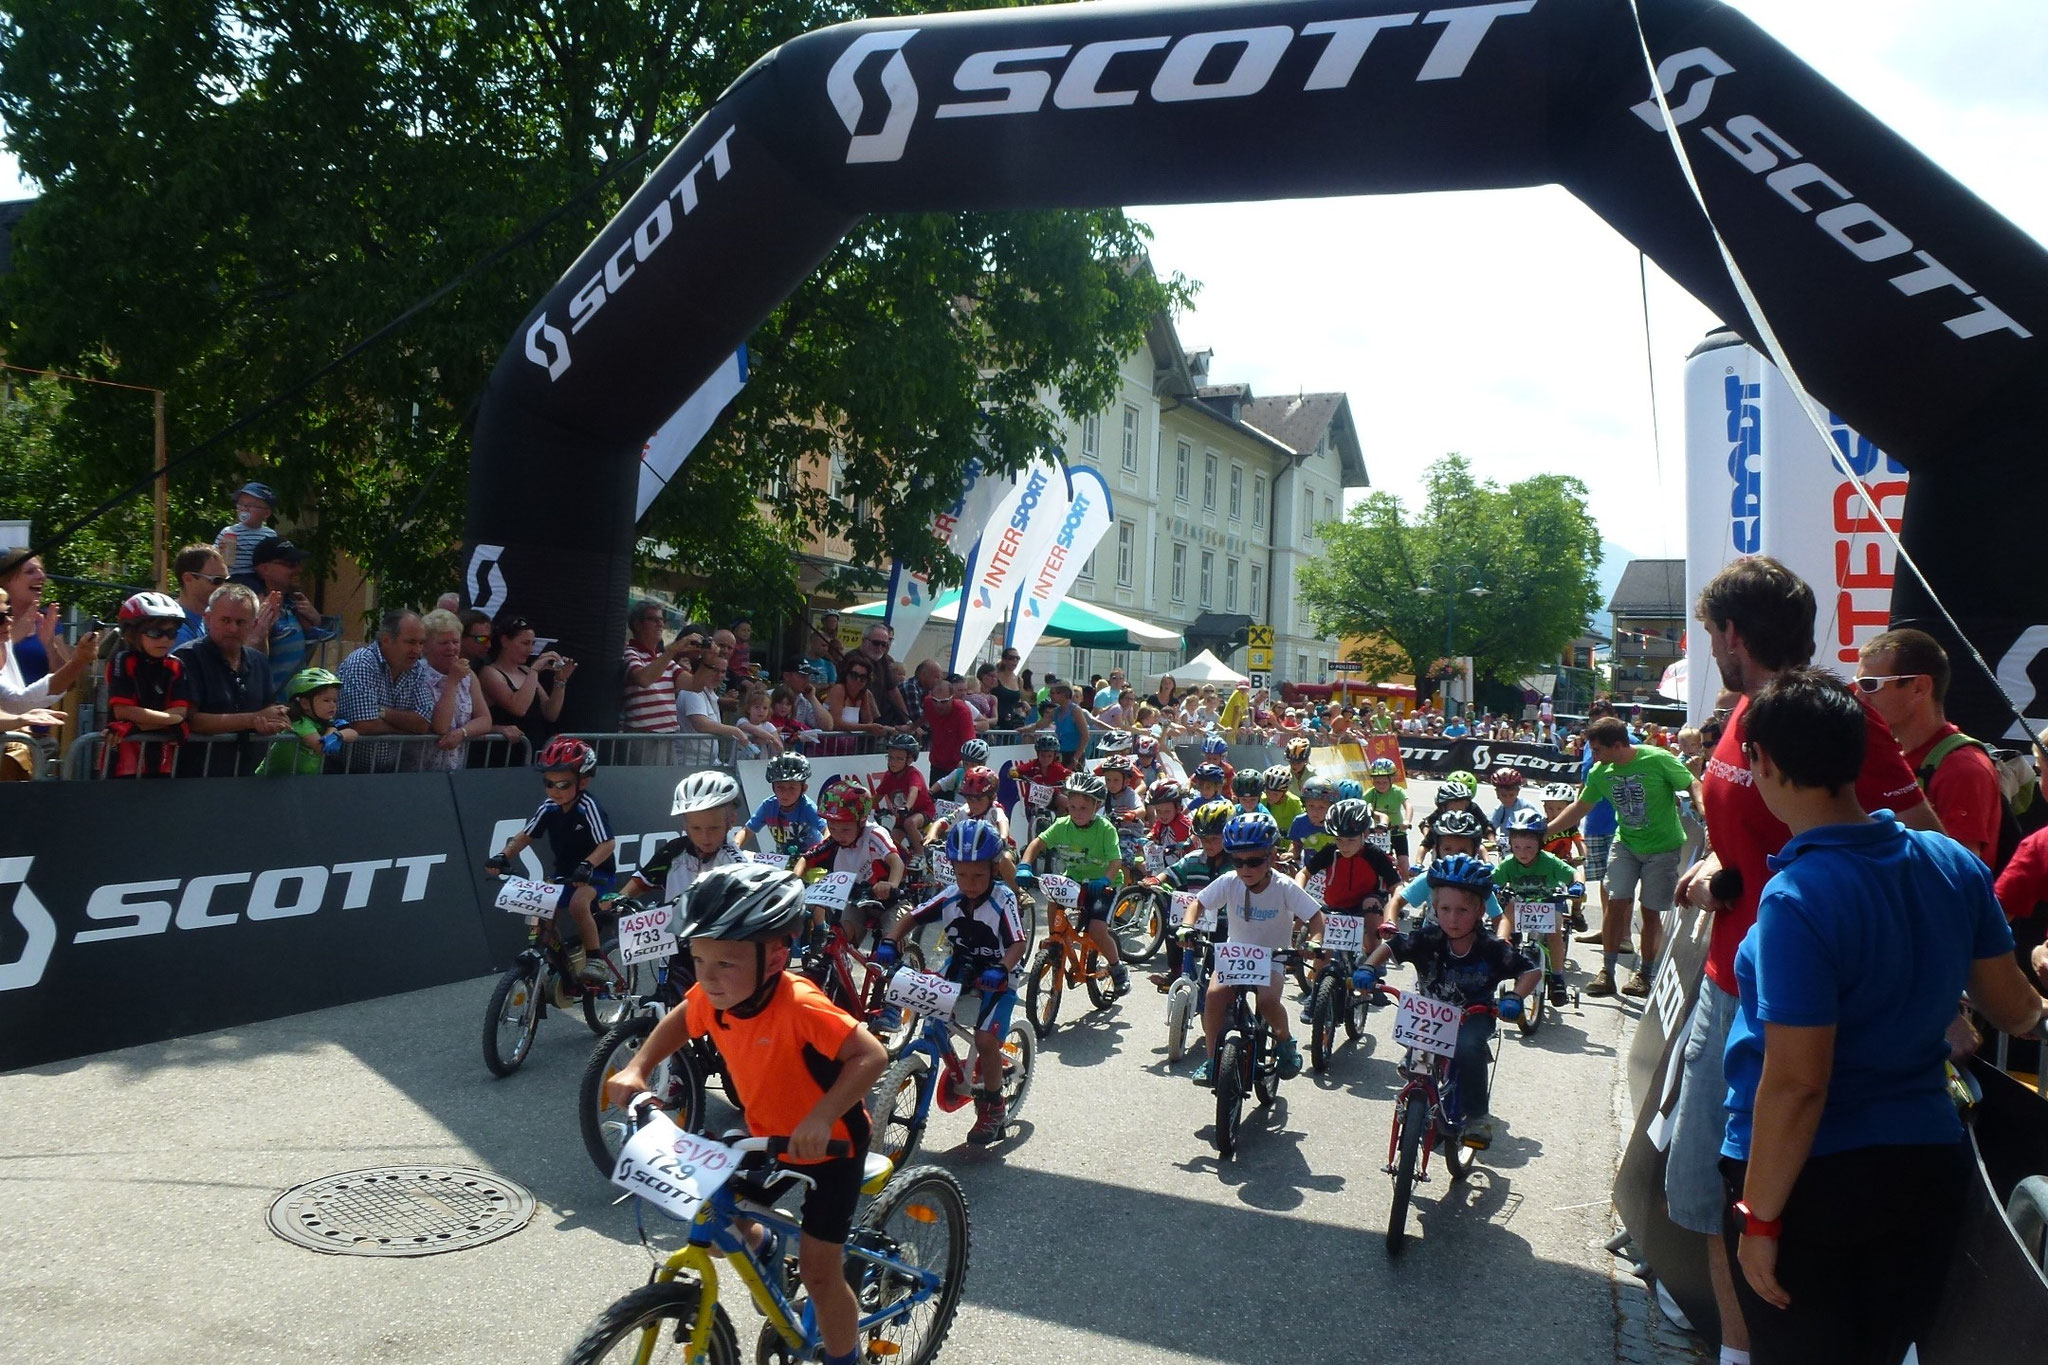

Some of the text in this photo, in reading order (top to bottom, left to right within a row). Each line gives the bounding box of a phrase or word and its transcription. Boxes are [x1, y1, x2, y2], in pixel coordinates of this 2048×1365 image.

[935, 1, 1537, 119] SCOTT
[571, 124, 736, 335] SCOTT
[1701, 114, 2034, 340] SCOTT
[983, 469, 1049, 589] INTERSPORT
[1032, 492, 1091, 600] INTERSPORT
[1401, 747, 1449, 761] OTT
[1493, 752, 1583, 773] SCOTT
[73, 853, 447, 944] SCOTT
[516, 889, 543, 904] 734
[813, 884, 837, 895] 742
[1048, 887, 1068, 897] 738
[506, 899, 554, 915] SCOTT
[806, 895, 845, 904] SCOTT
[1524, 914, 1545, 923] 747
[633, 928, 661, 946] 733
[1328, 928, 1351, 939] 737
[633, 940, 675, 958] SCOTT
[1228, 959, 1256, 971] 730
[1225, 973, 1269, 981] SCOTT
[907, 982, 939, 1005] 732
[1410, 1014, 1443, 1036] 727
[1402, 1031, 1455, 1050] SCOTT
[647, 1148, 696, 1181] 729
[630, 1169, 703, 1205] SCOTT
